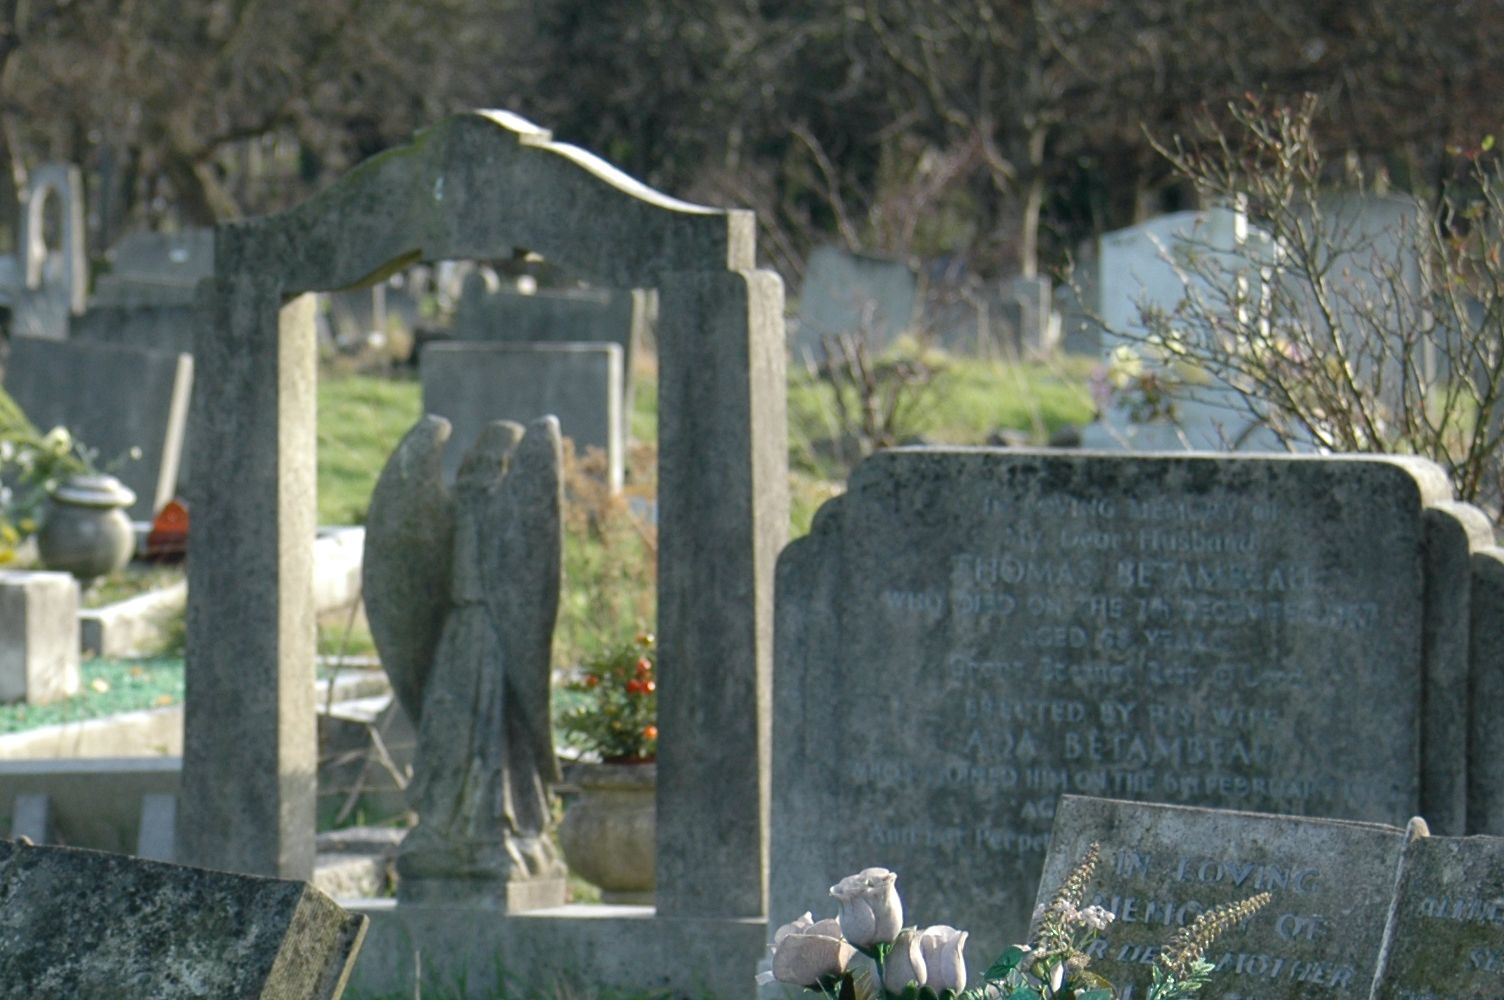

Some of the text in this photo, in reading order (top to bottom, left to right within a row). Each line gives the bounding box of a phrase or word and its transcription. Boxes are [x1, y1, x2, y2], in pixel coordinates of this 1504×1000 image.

[1138, 526, 1259, 556] Husband
[952, 555, 1097, 588] THOMAS
[965, 699, 1085, 724] ERECTED
[1099, 702, 1135, 725] BY
[1116, 850, 1320, 893] IN LOVING
[1273, 914, 1325, 942] OF
